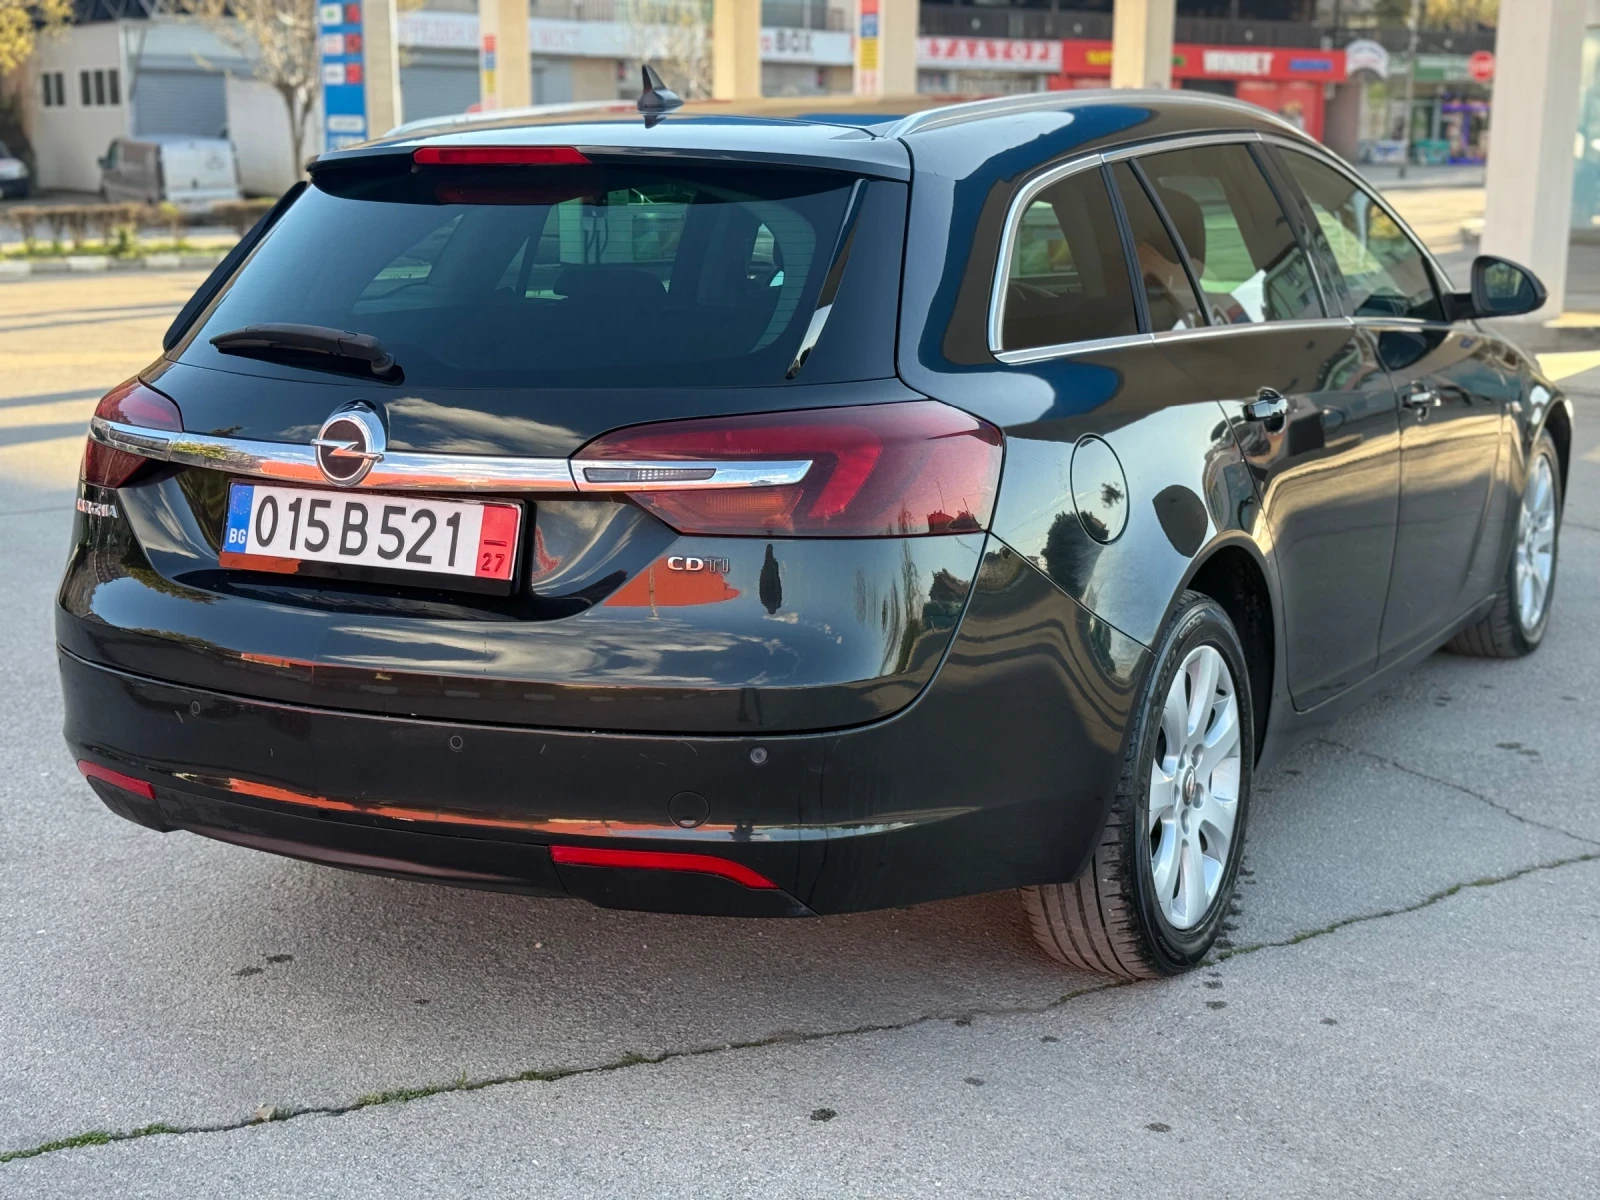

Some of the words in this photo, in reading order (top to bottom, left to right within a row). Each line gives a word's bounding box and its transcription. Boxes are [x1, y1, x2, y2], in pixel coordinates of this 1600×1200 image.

[229, 527, 247, 545] BG
[255, 494, 462, 567] 015B521
[480, 553, 506, 573] 27
[667, 556, 730, 573] CDTI
